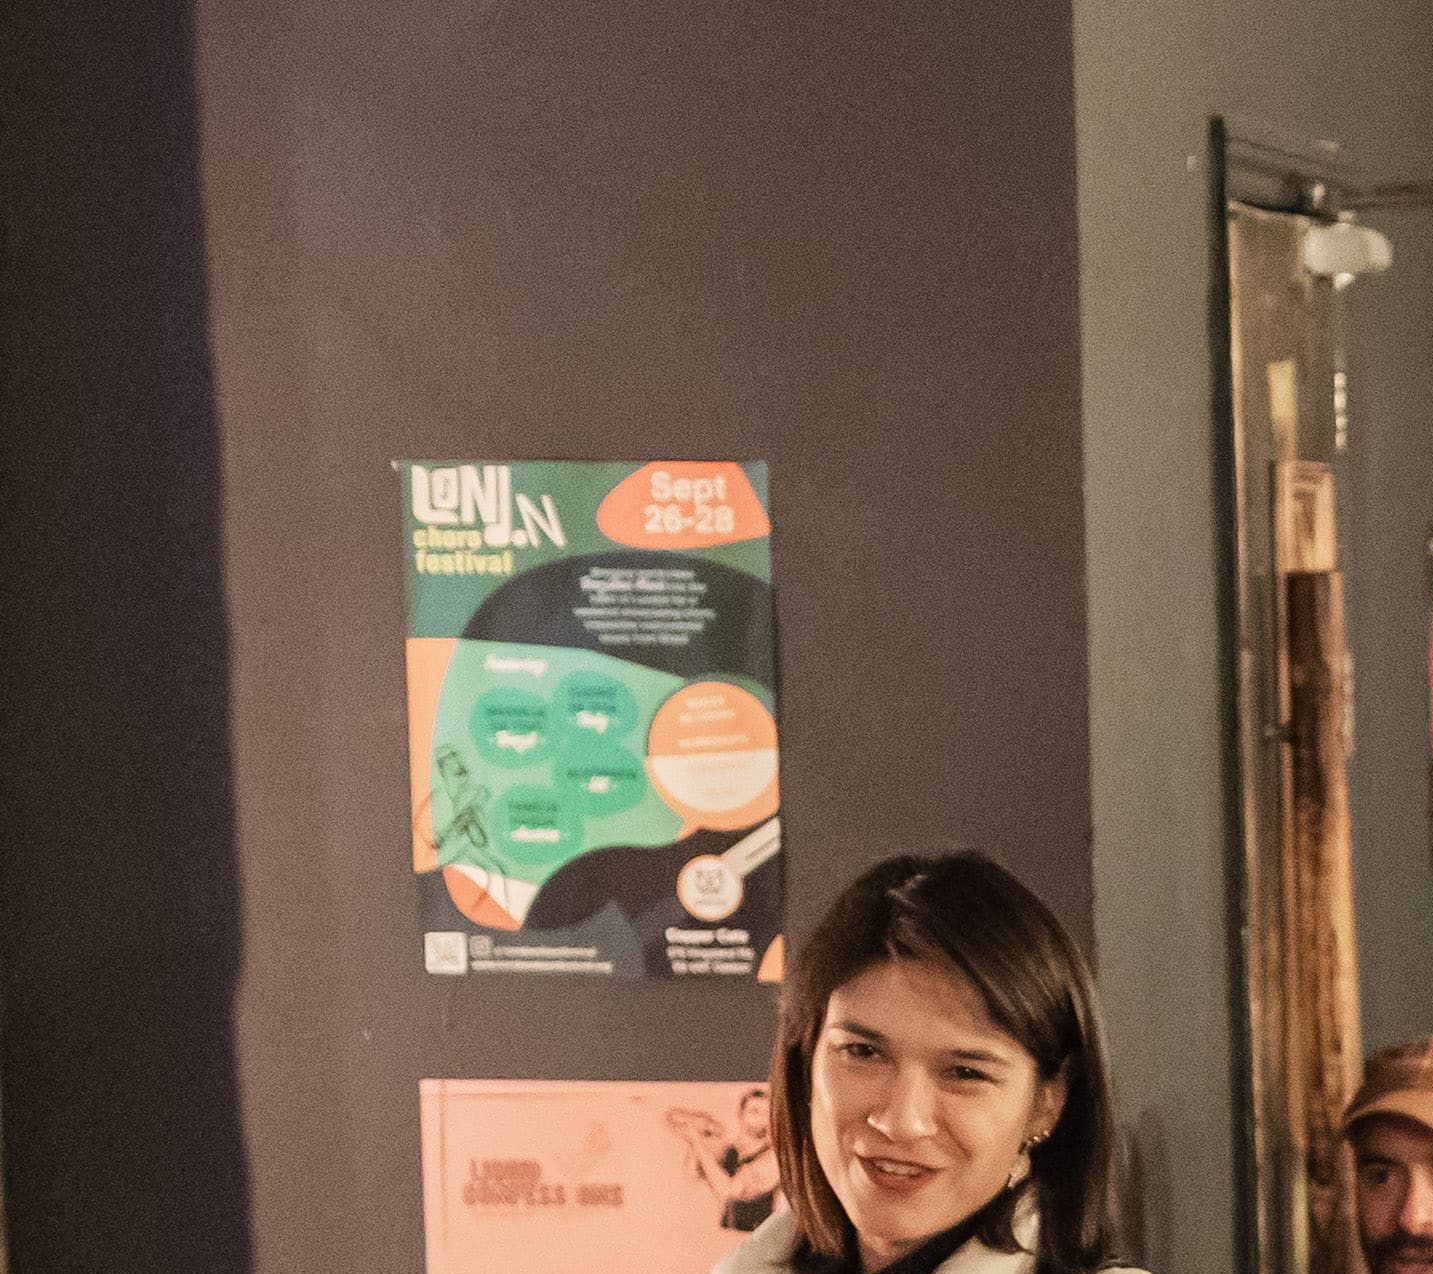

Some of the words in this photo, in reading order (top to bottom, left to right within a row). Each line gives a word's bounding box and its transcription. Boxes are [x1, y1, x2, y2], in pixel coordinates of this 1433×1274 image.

[651, 470, 727, 509] Sept
[643, 504, 735, 534] 26-28
[415, 551, 513, 575] festival
